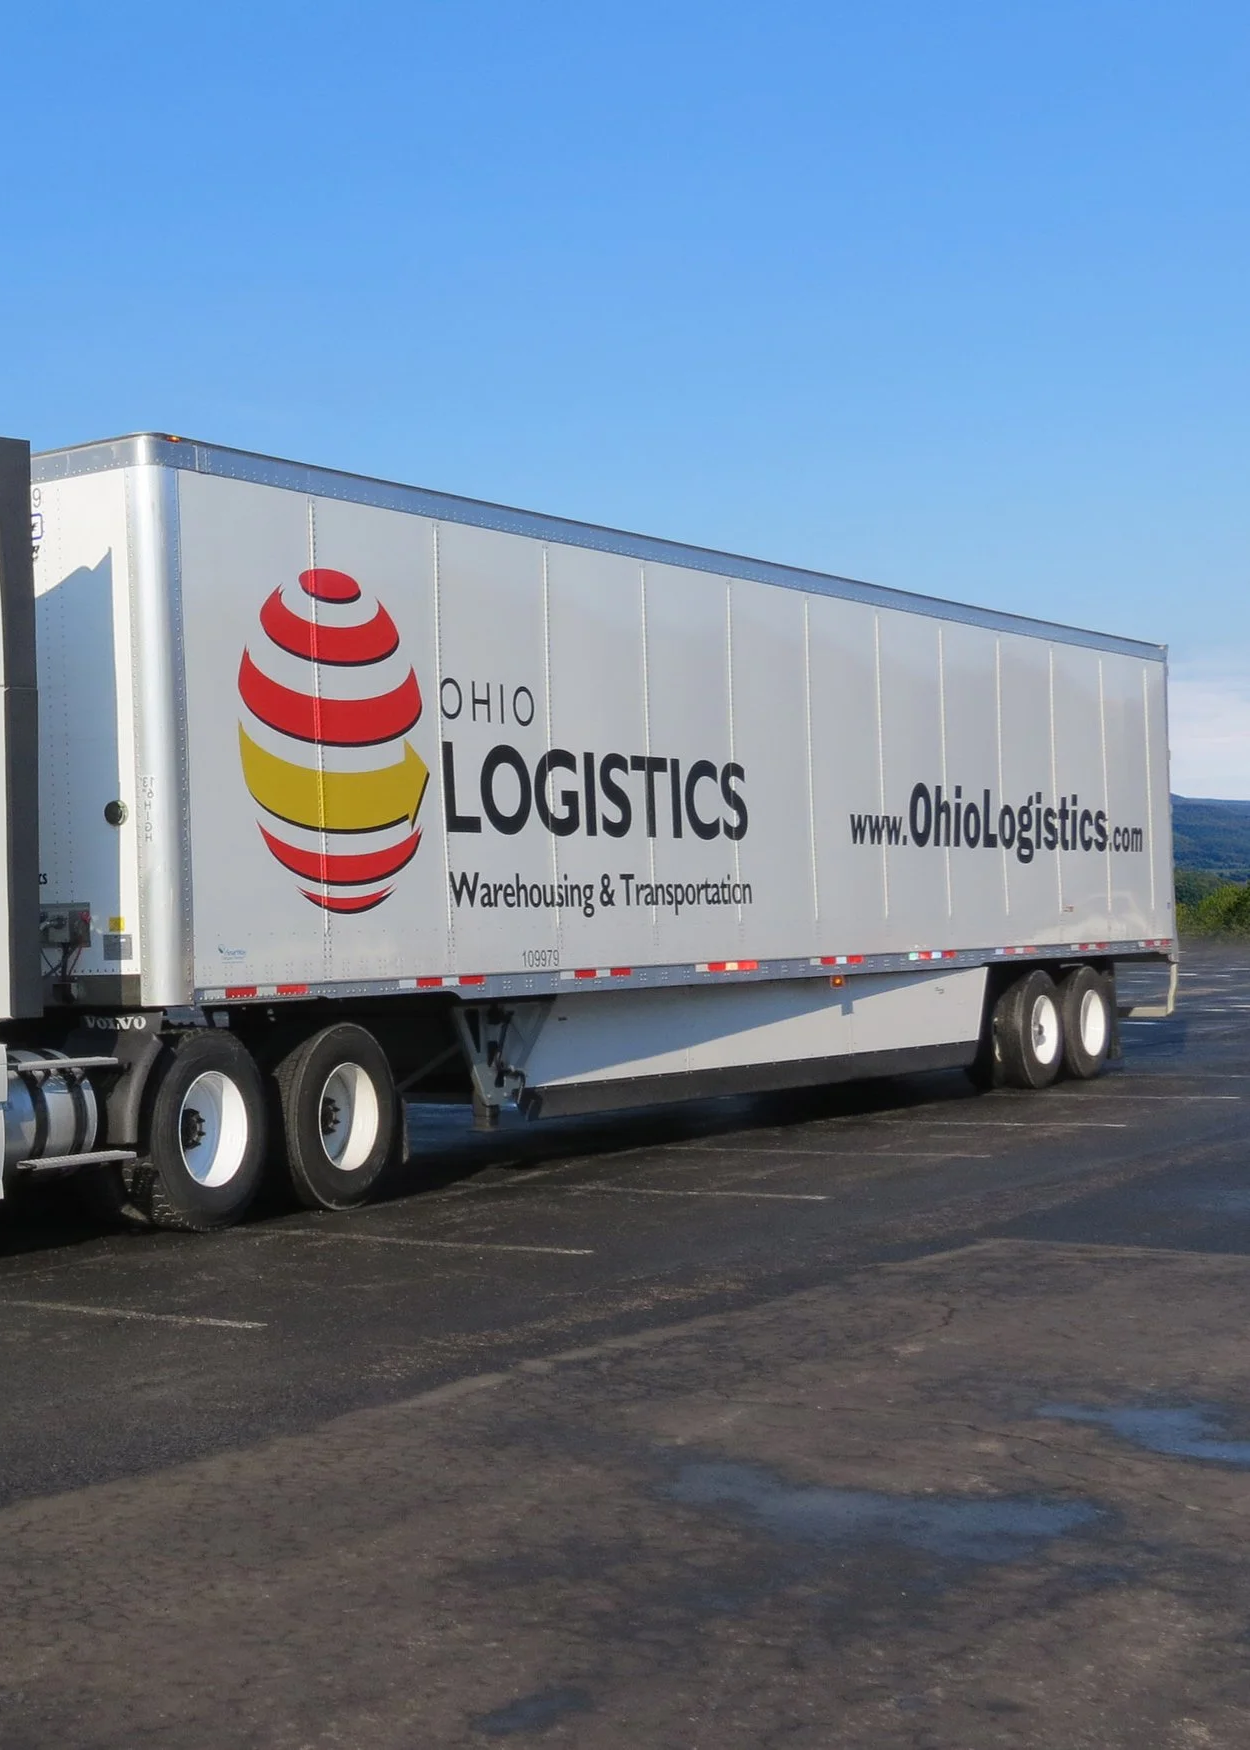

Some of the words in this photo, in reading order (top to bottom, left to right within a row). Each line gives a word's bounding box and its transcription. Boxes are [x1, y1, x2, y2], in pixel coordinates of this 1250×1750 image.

[440, 677, 535, 727] OHIO
[442, 740, 749, 841] LOGISTICS
[849, 782, 1144, 864] www.OhioLogistics.com
[449, 871, 595, 918] Warehousing
[600, 873, 616, 907] &
[619, 873, 753, 916] Transportation
[522, 949, 560, 968] 109979
[83, 1015, 147, 1030] VOLVO
